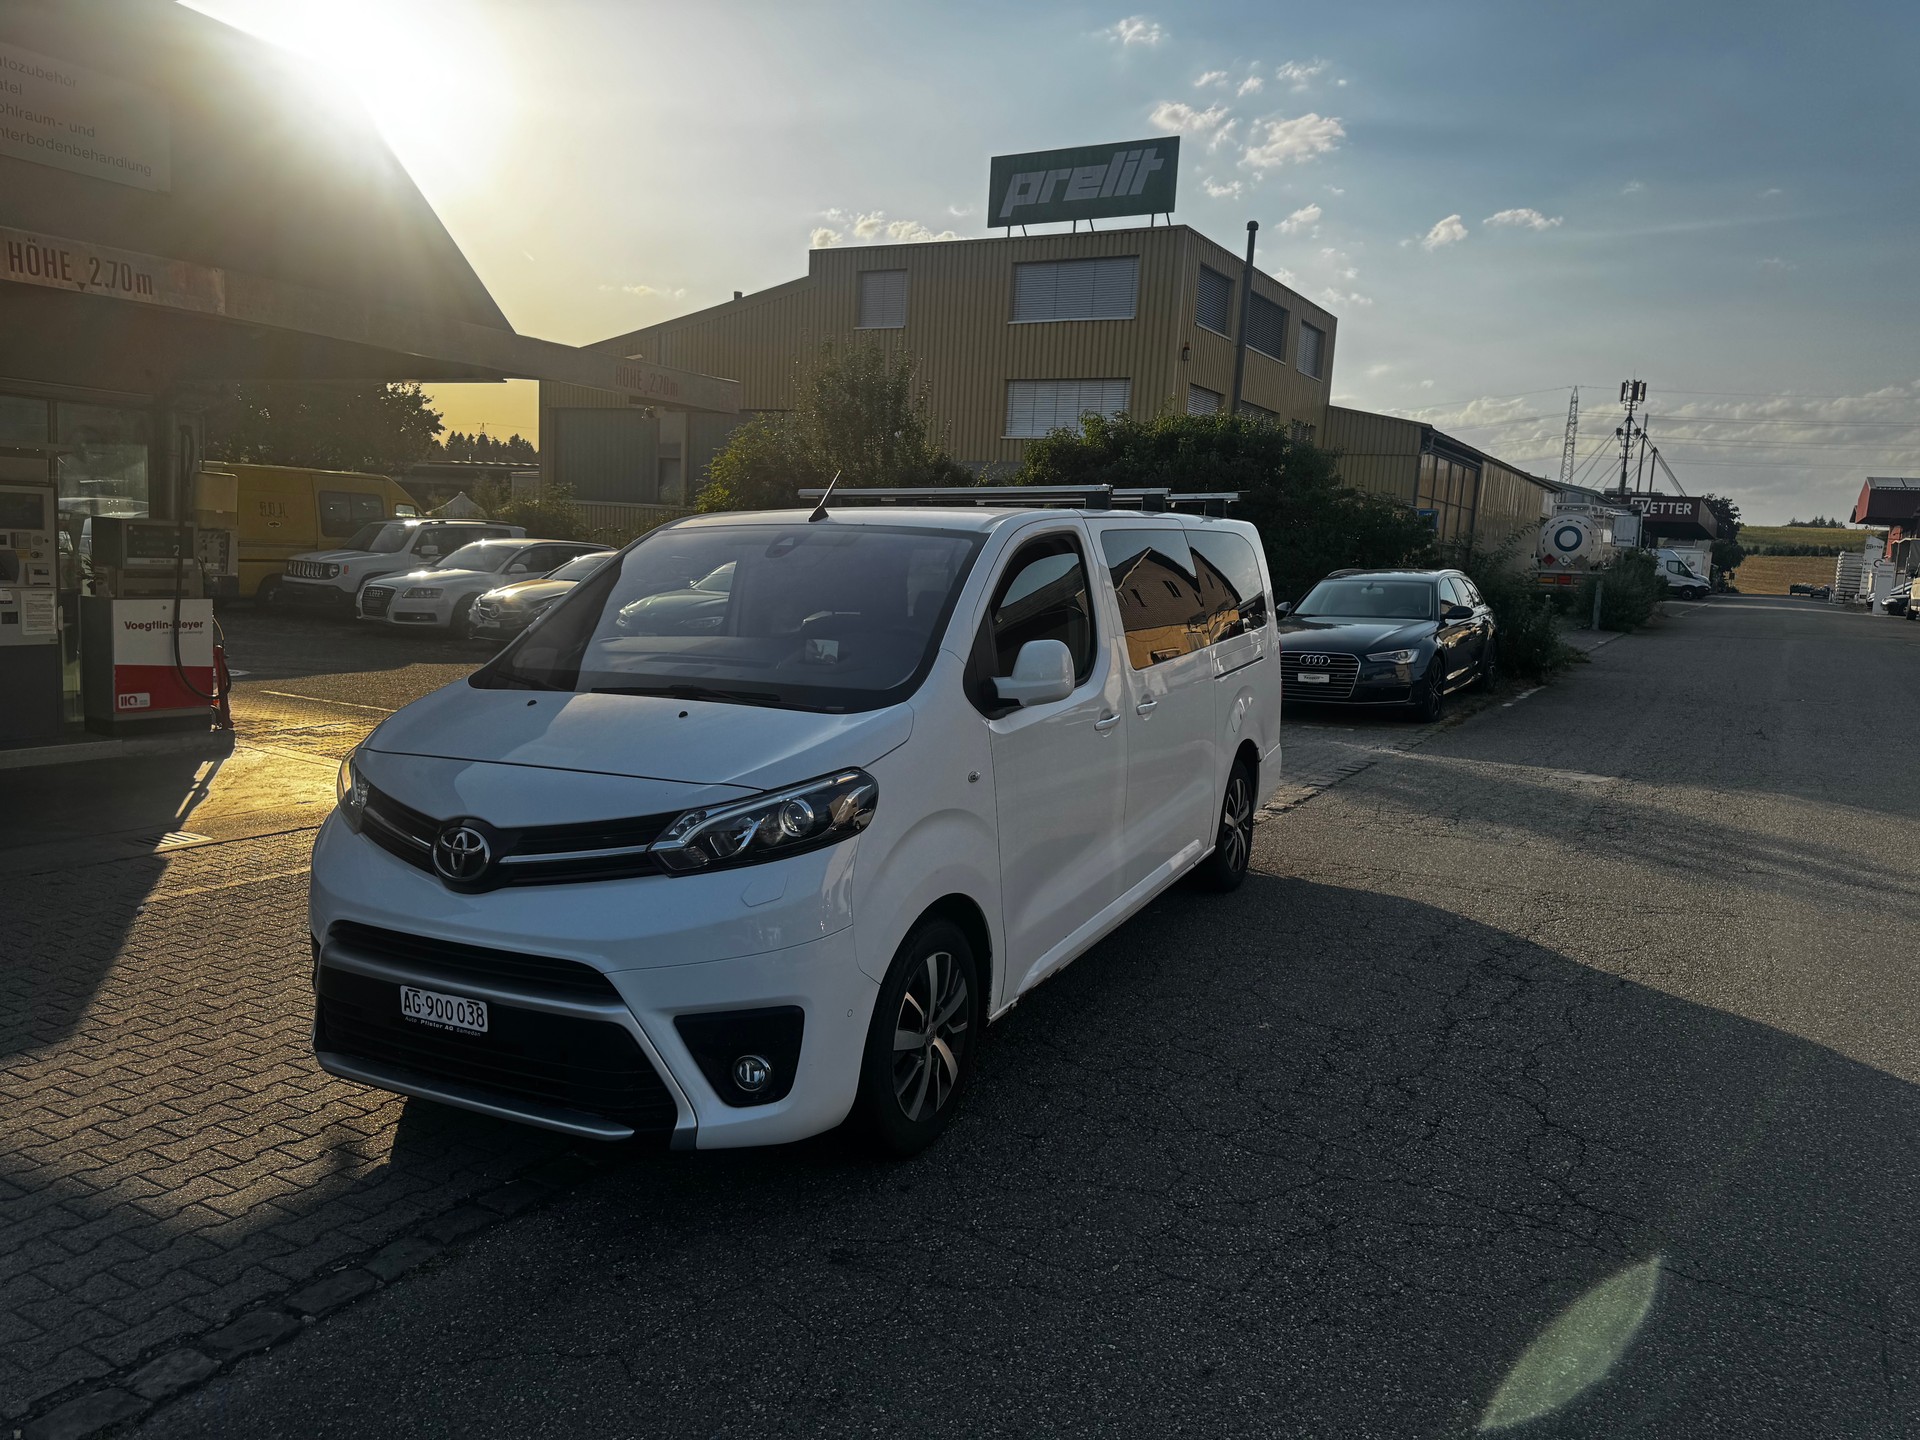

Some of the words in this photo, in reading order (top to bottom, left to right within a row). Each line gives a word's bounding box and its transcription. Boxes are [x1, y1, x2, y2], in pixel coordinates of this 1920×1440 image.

[69, 123, 95, 138] und
[999, 147, 1165, 218] prelit
[8, 238, 73, 281] HÖHE
